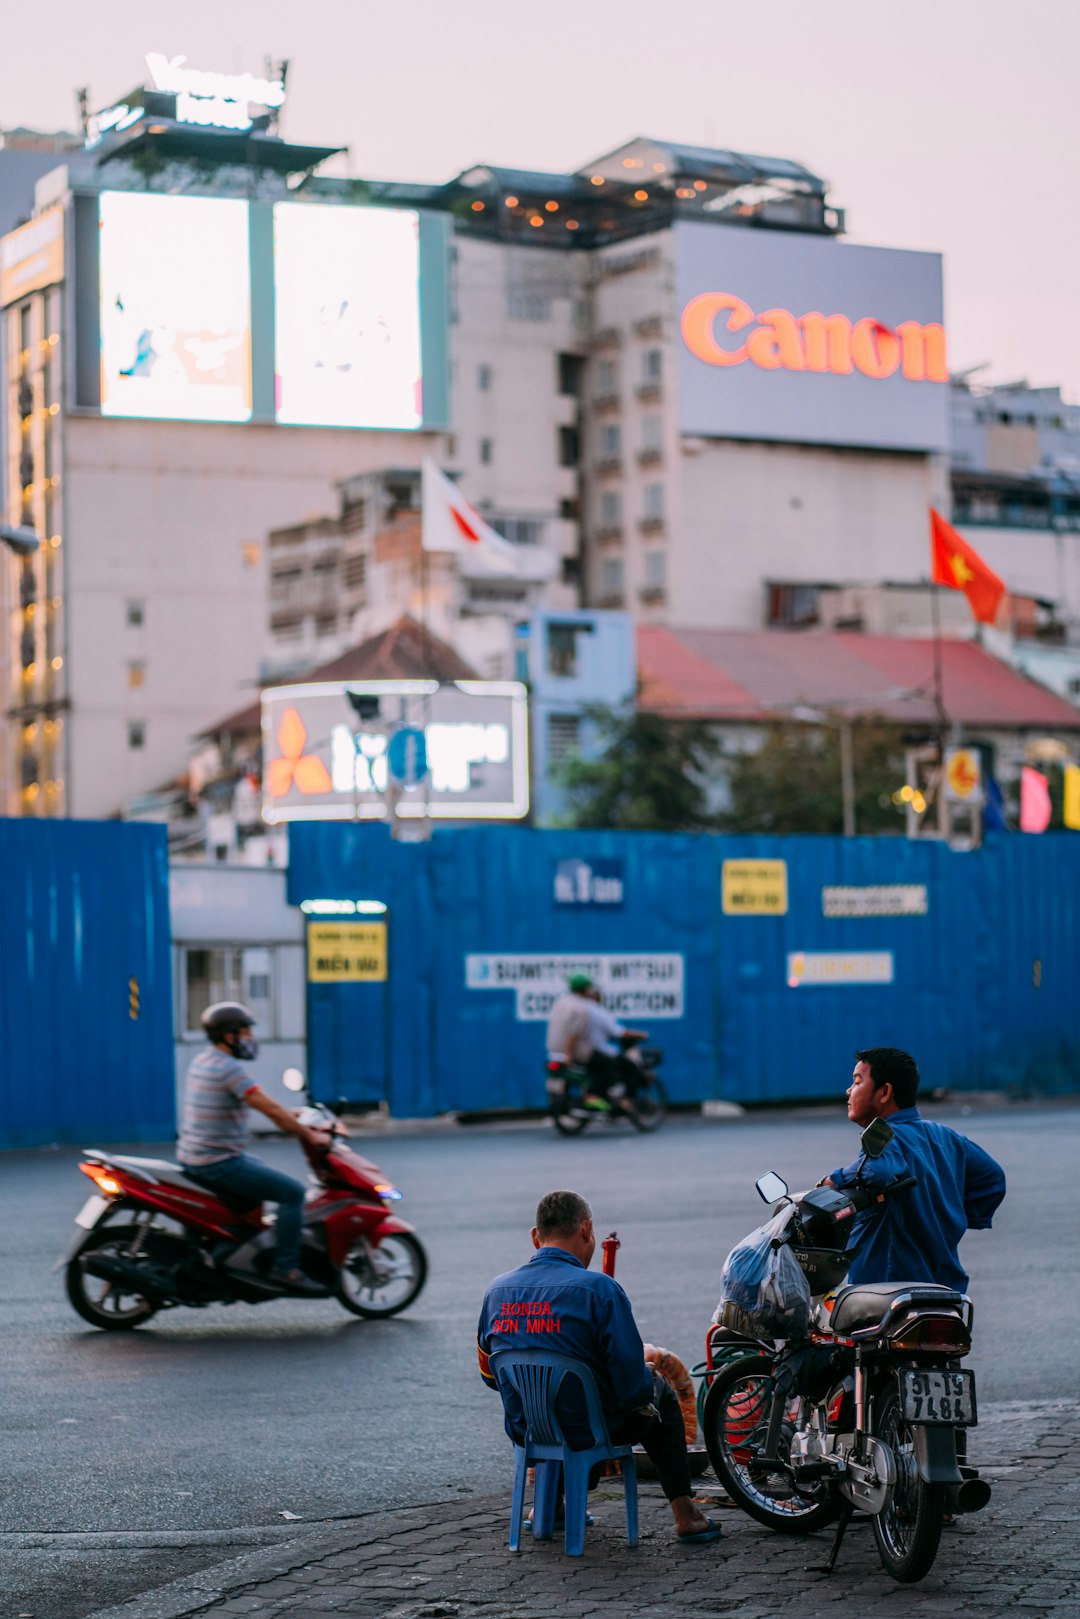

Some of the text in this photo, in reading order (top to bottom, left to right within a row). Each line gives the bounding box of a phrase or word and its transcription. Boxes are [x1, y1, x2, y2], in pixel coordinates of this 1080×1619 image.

[681, 291, 949, 383] Canon
[500, 1301, 553, 1316] HONDA
[526, 1318, 561, 1333] MINH
